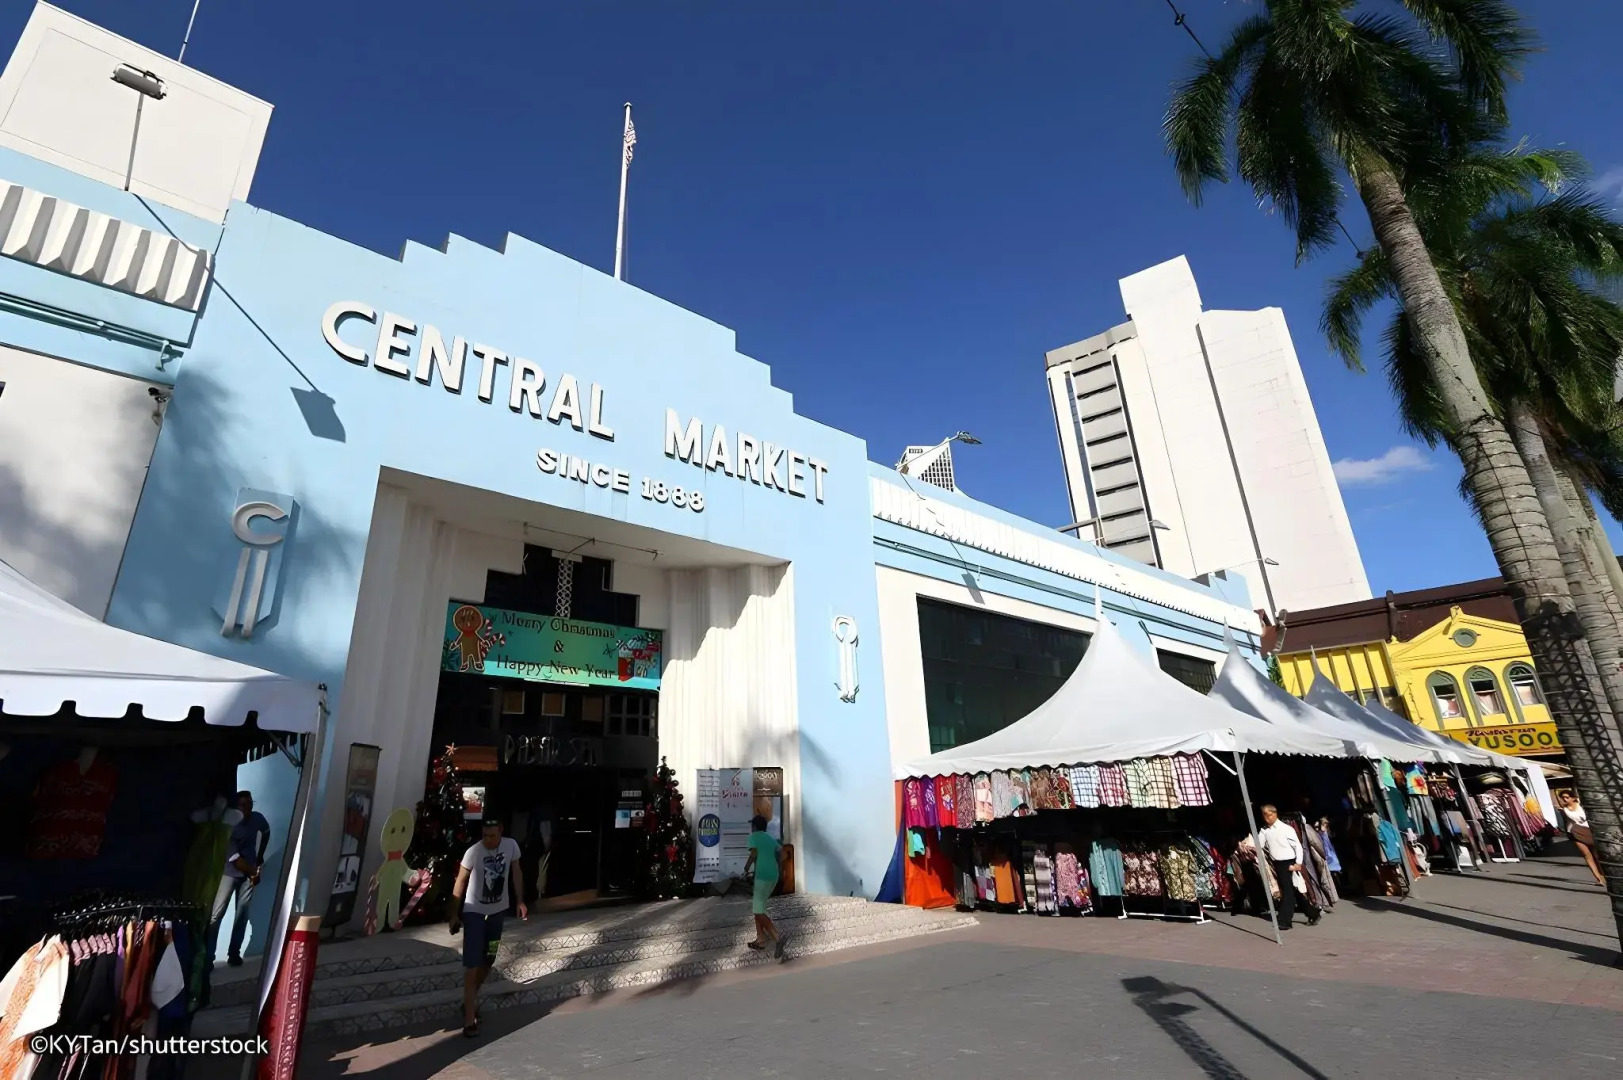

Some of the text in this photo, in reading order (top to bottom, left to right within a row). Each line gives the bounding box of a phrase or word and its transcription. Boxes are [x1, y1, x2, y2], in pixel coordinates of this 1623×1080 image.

[321, 301, 828, 504] CENTRAL MARKET
[536, 447, 704, 512] SINCE 1888
[553, 640, 564, 653] &
[496, 654, 616, 679] Happy New Year
[1467, 732, 1561, 749] YUSOO
